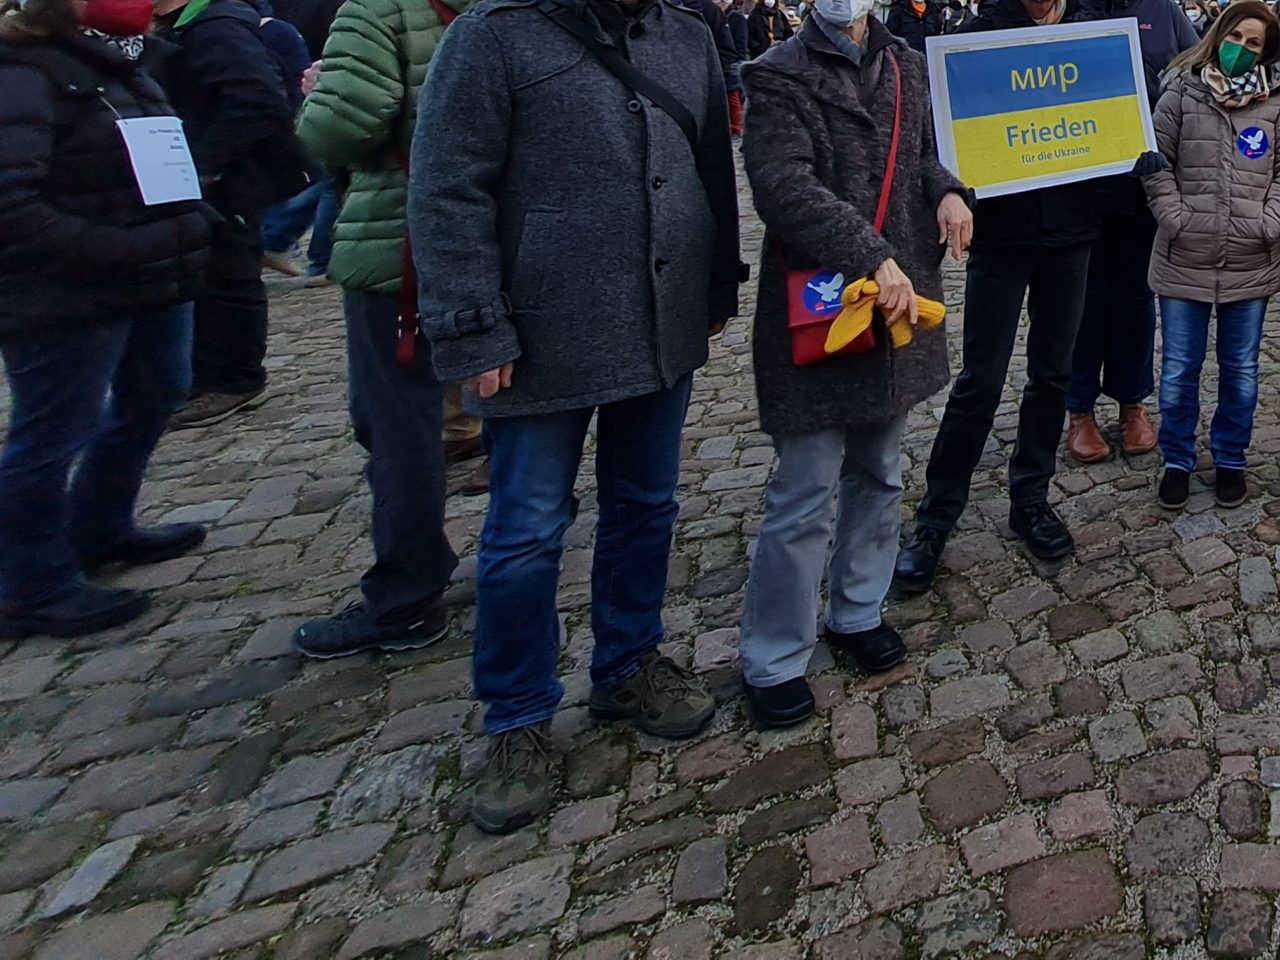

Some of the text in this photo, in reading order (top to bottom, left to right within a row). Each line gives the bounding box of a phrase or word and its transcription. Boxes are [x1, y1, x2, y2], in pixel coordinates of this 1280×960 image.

[1011, 62, 1079, 93] мир
[1006, 117, 1097, 147] Frieden
[1022, 145, 1090, 163] für die Ukraine
